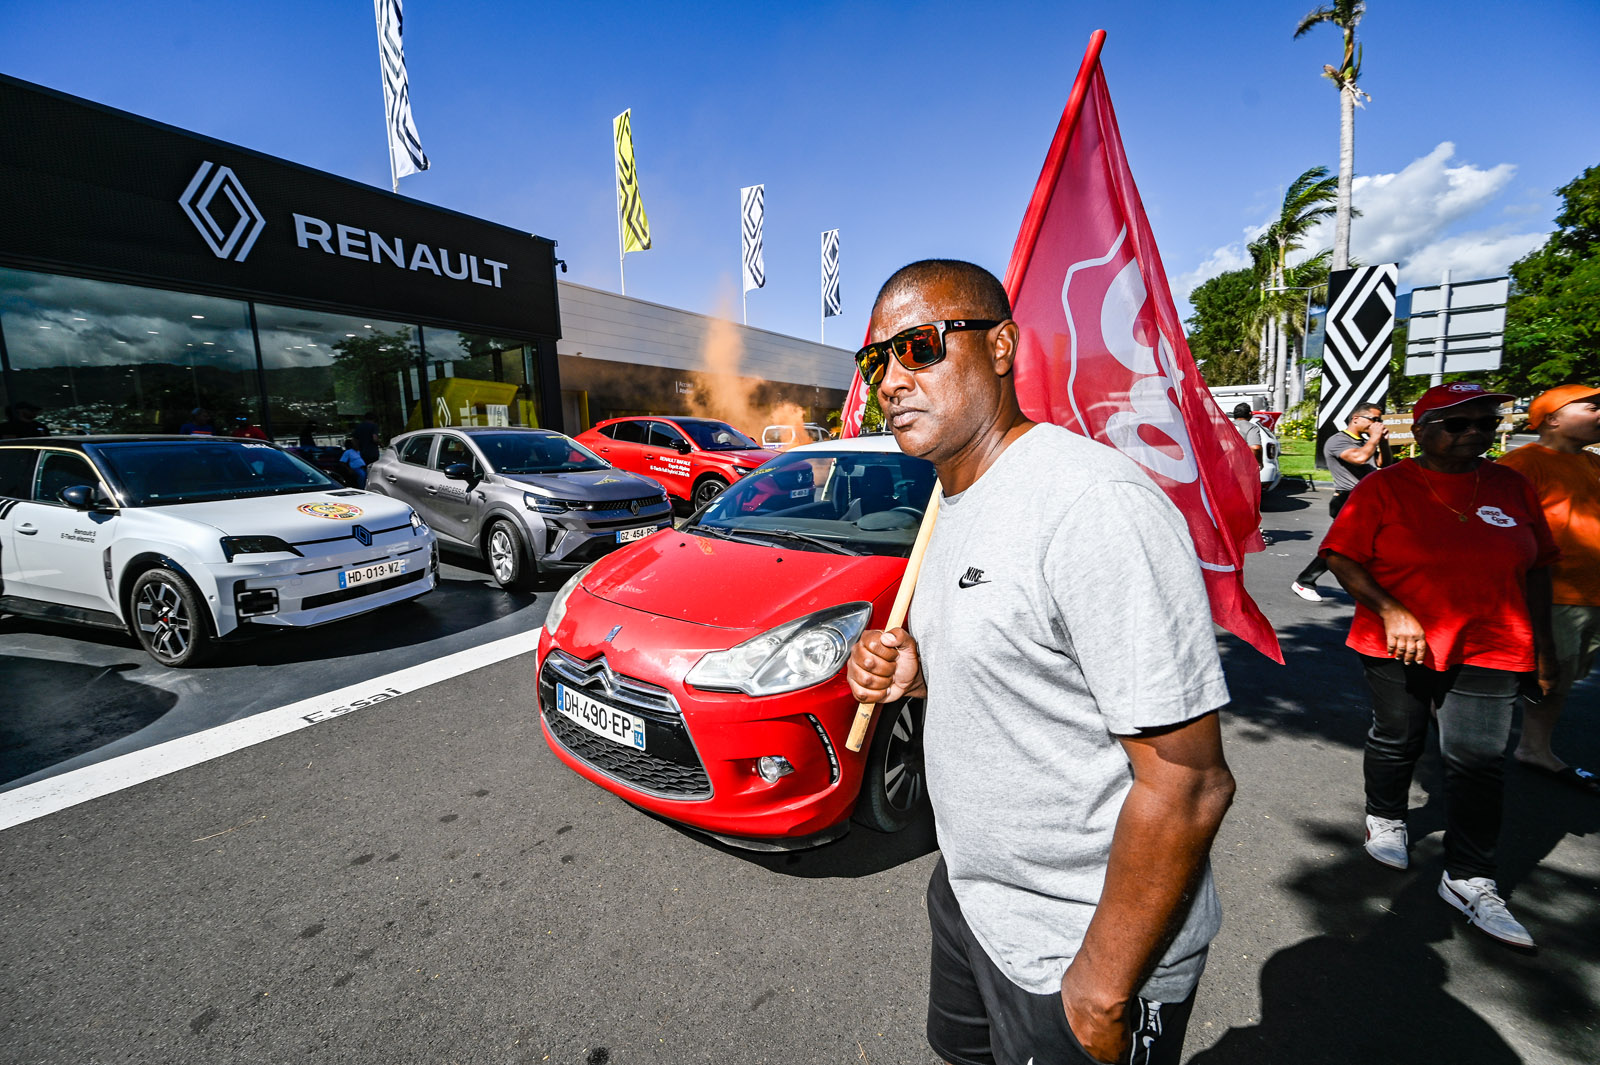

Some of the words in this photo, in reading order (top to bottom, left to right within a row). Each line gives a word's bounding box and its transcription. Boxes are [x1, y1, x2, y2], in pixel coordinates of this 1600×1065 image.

[292, 212, 509, 289] RENAULT
[347, 561, 400, 584] HD-013-WZ
[964, 566, 985, 582] NIKE
[301, 686, 403, 723] Essai
[564, 690, 631, 739] DH-490-EP
